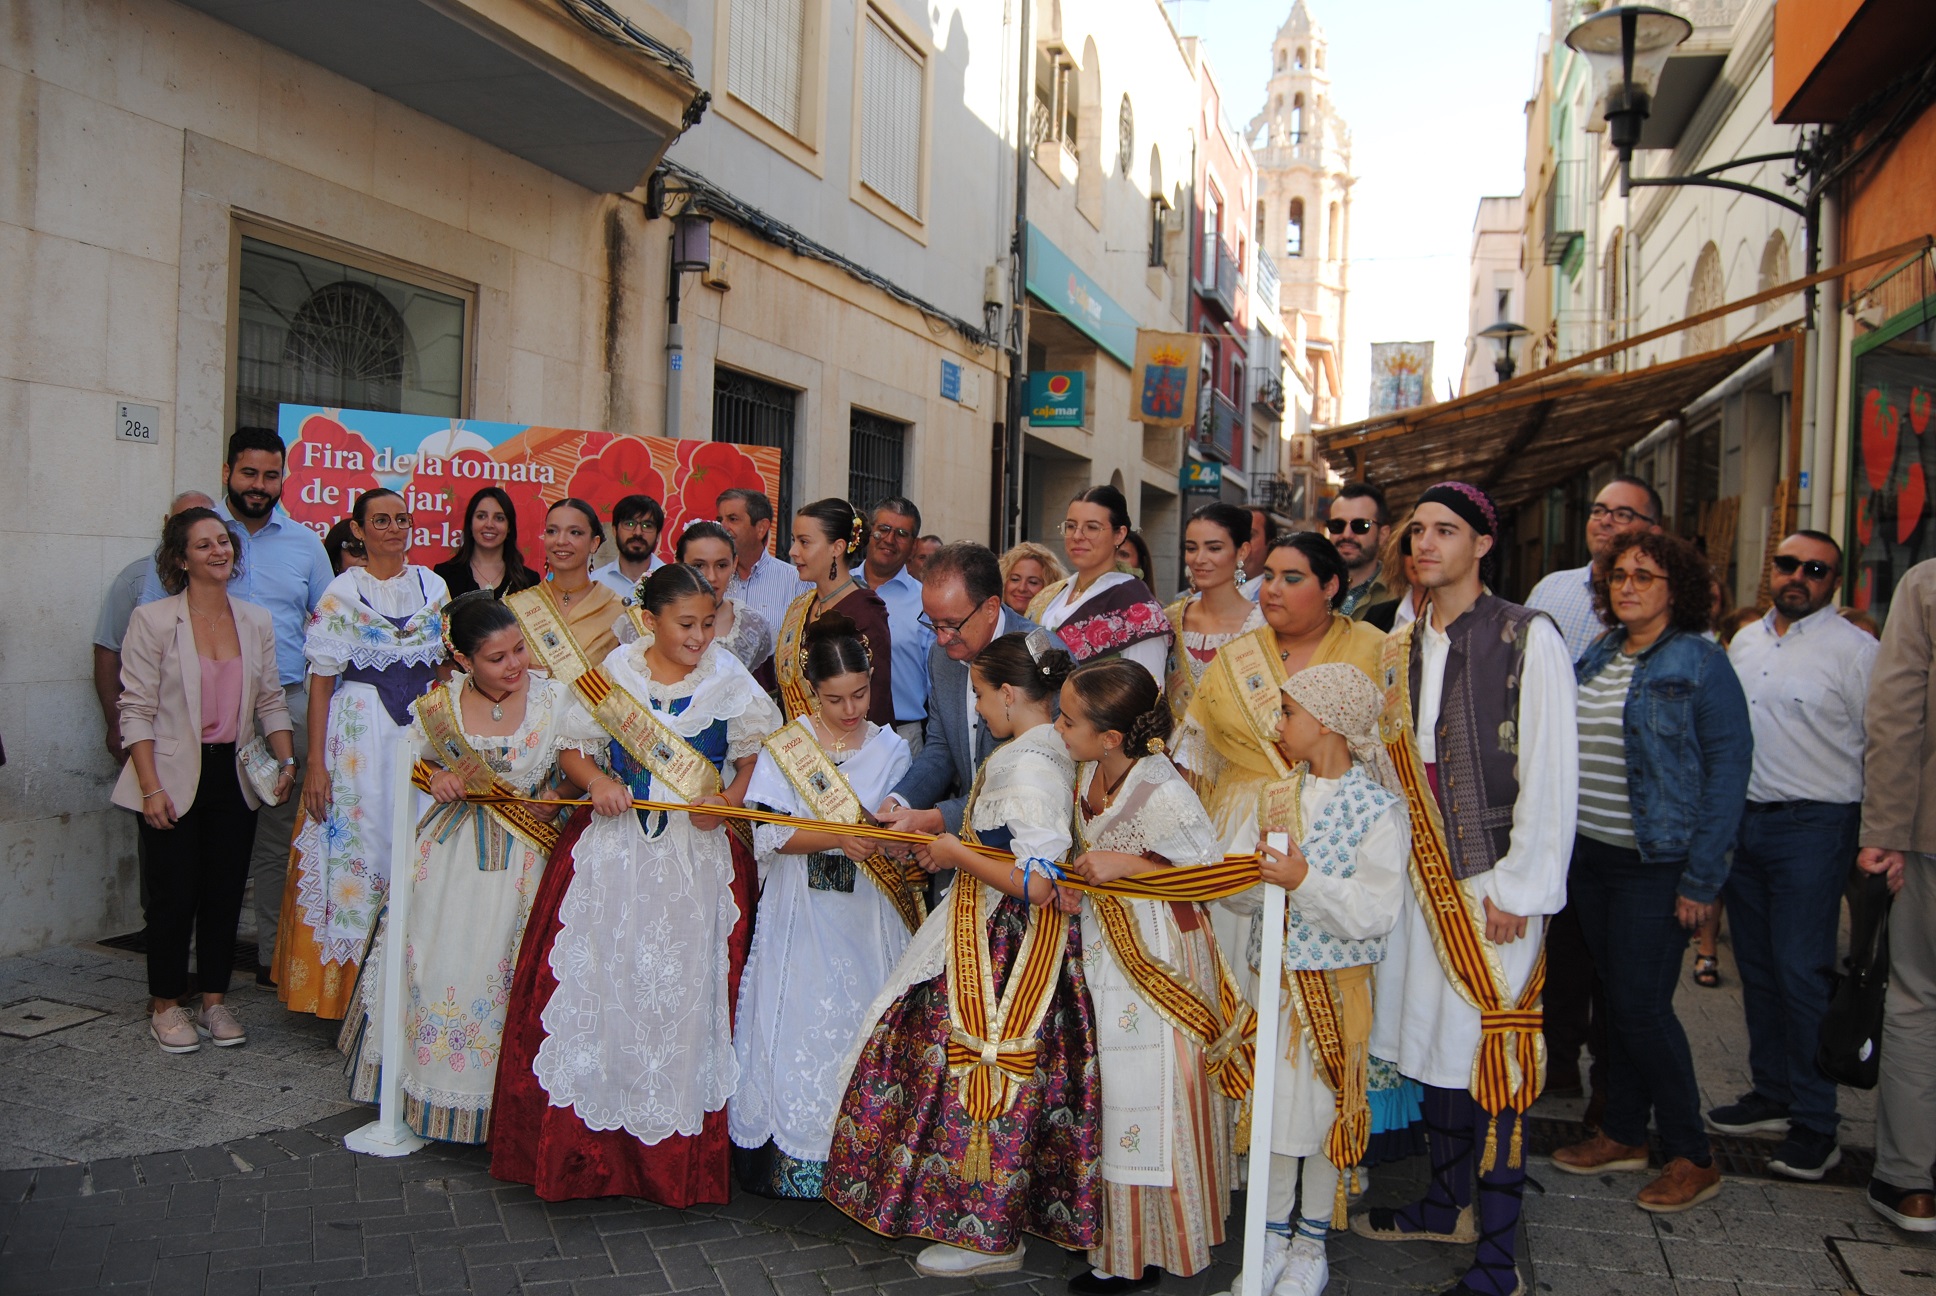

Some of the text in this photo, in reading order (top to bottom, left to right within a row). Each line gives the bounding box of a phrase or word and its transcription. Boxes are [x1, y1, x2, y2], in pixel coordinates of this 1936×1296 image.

[1033, 405, 1079, 419] cajamar
[125, 420, 149, 439] 28a
[303, 441, 556, 484] Fira de la tomata
[1190, 464, 1219, 484] 24h
[301, 477, 453, 515] de pjar,
[524, 606, 542, 617] 2022
[426, 702, 442, 718] 2022
[620, 712, 637, 732] 2022
[782, 737, 802, 754] 2022
[1268, 786, 1290, 798] 2022
